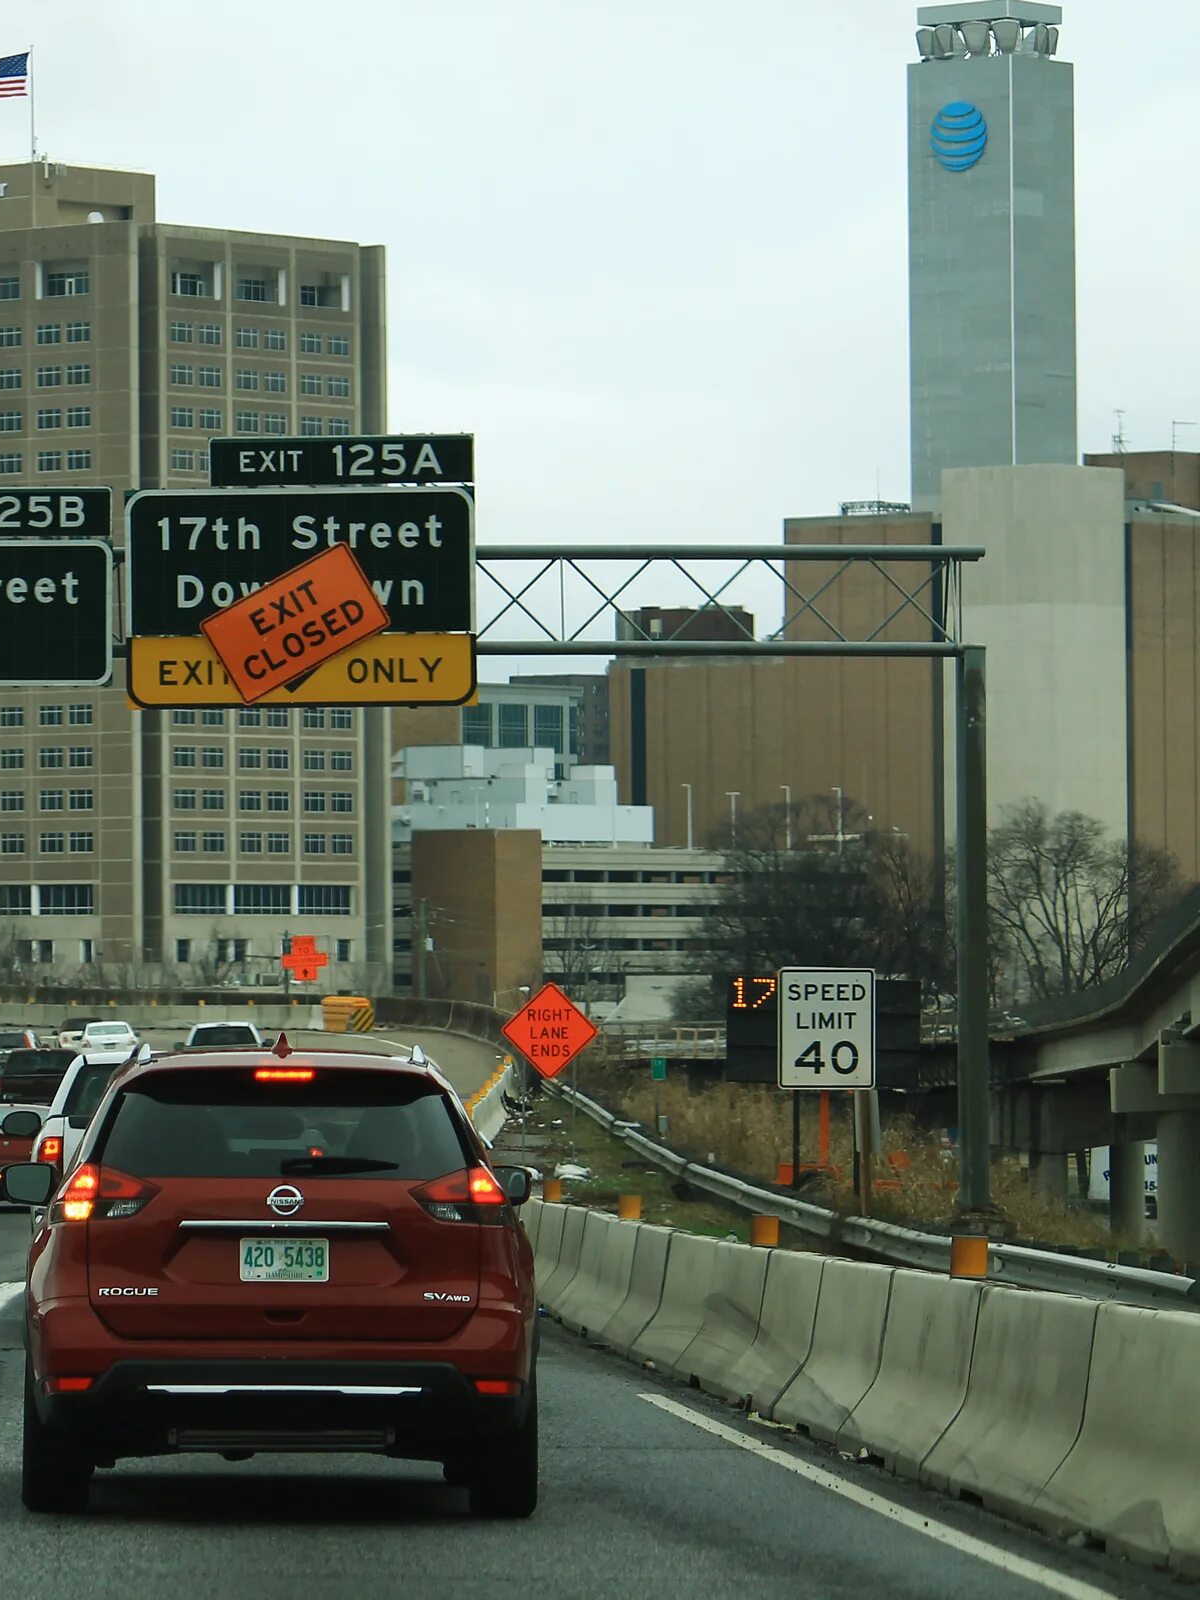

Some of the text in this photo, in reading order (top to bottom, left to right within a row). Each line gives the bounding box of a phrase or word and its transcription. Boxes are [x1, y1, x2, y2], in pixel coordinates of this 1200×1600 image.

[239, 443, 443, 476] EXIT 125A
[157, 514, 443, 551] 17th Street
[248, 579, 319, 636] EXIT
[243, 599, 365, 681] CLOSED
[347, 657, 443, 684] ONLY
[733, 976, 776, 1008] 17
[788, 984, 866, 1001] SPEED
[527, 1008, 572, 1021] RIGHT
[797, 1012, 857, 1029] LIMIT
[530, 1027, 569, 1039] LANE
[531, 1044, 571, 1057] ENDS
[794, 1040, 859, 1075] 40
[244, 1246, 324, 1268] 420 5438
[98, 1287, 159, 1296] ROGUE
